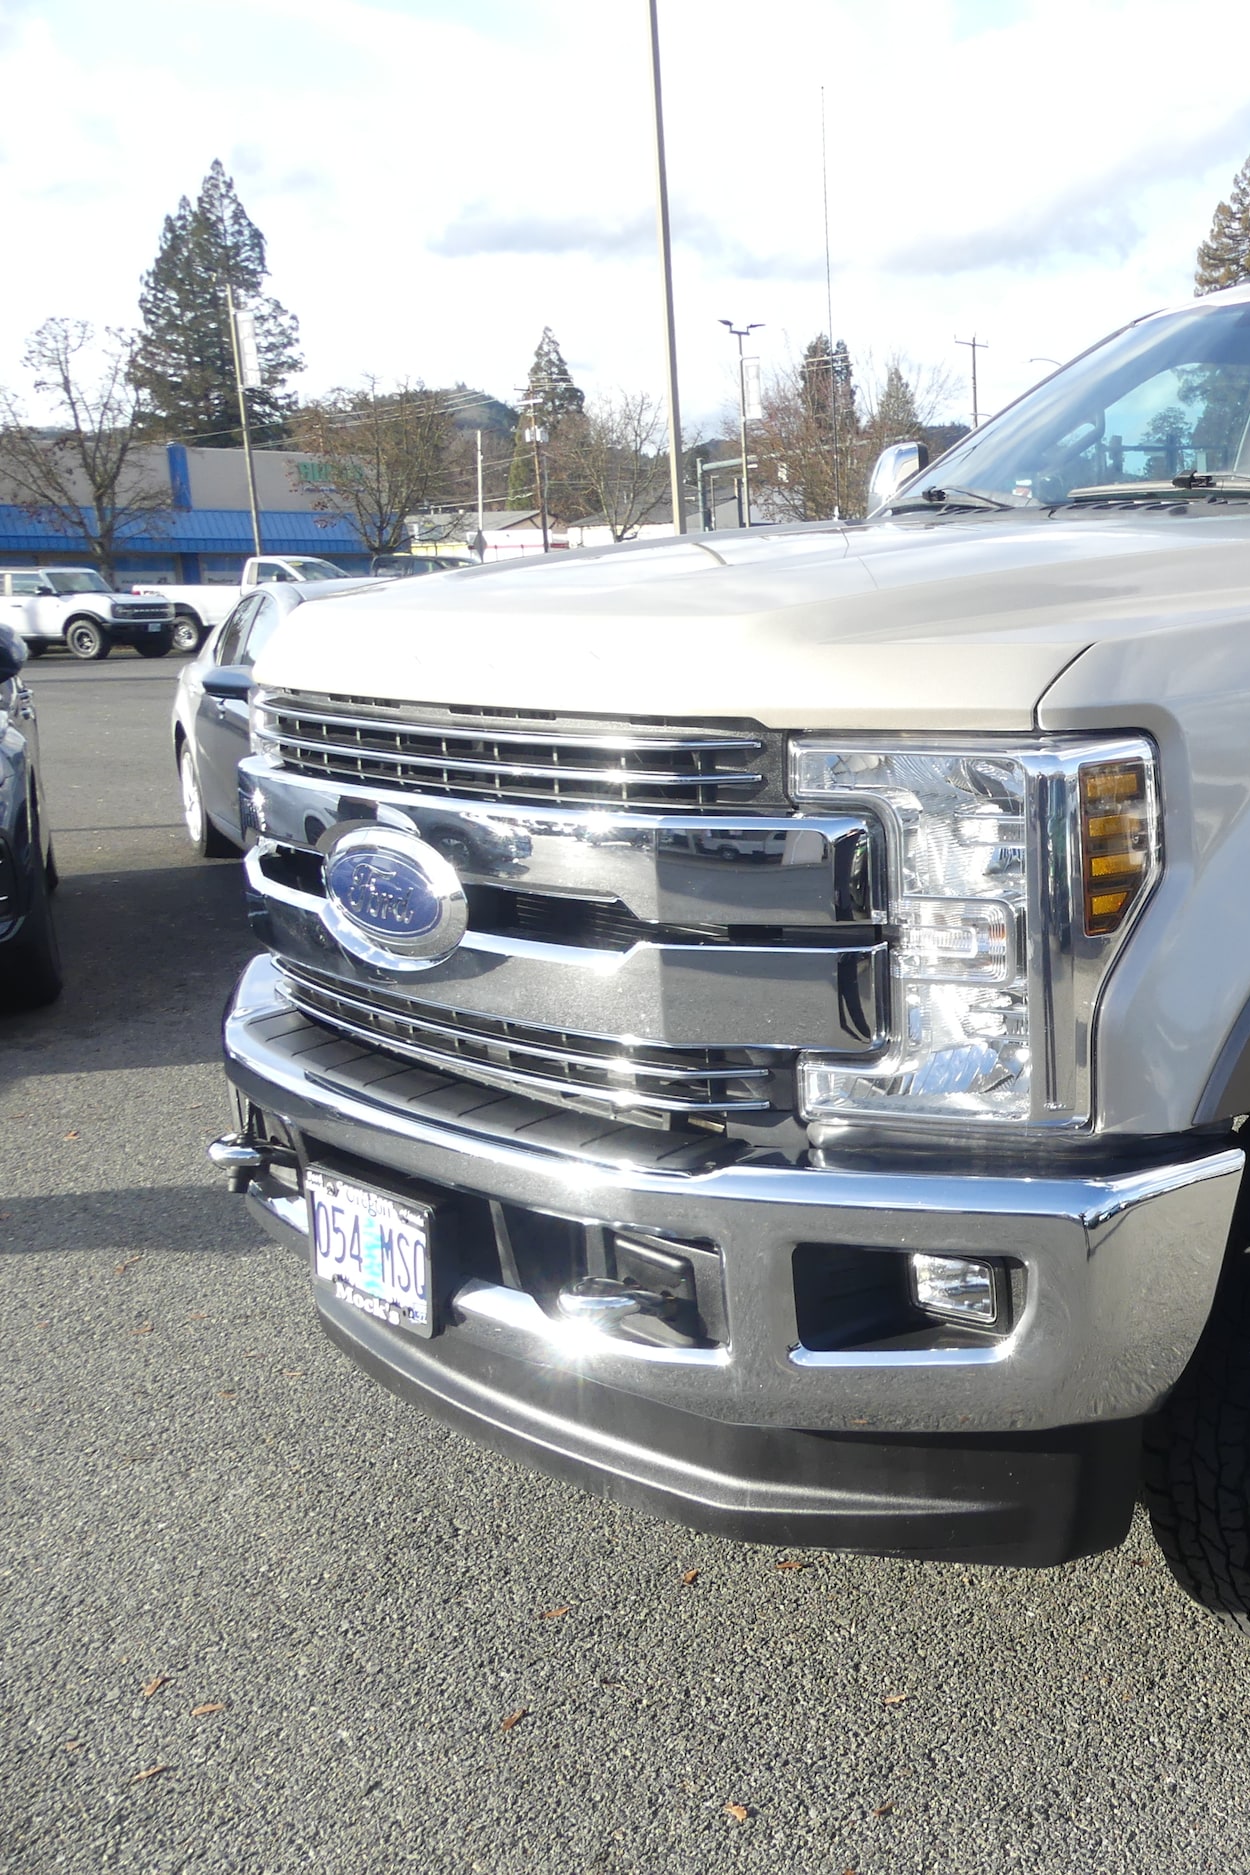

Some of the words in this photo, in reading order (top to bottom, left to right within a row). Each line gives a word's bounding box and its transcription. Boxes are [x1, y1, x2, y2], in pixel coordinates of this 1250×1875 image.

[349, 862, 415, 924] Ford
[315, 1201, 363, 1273] 054
[335, 1281, 400, 1325] Mock's
